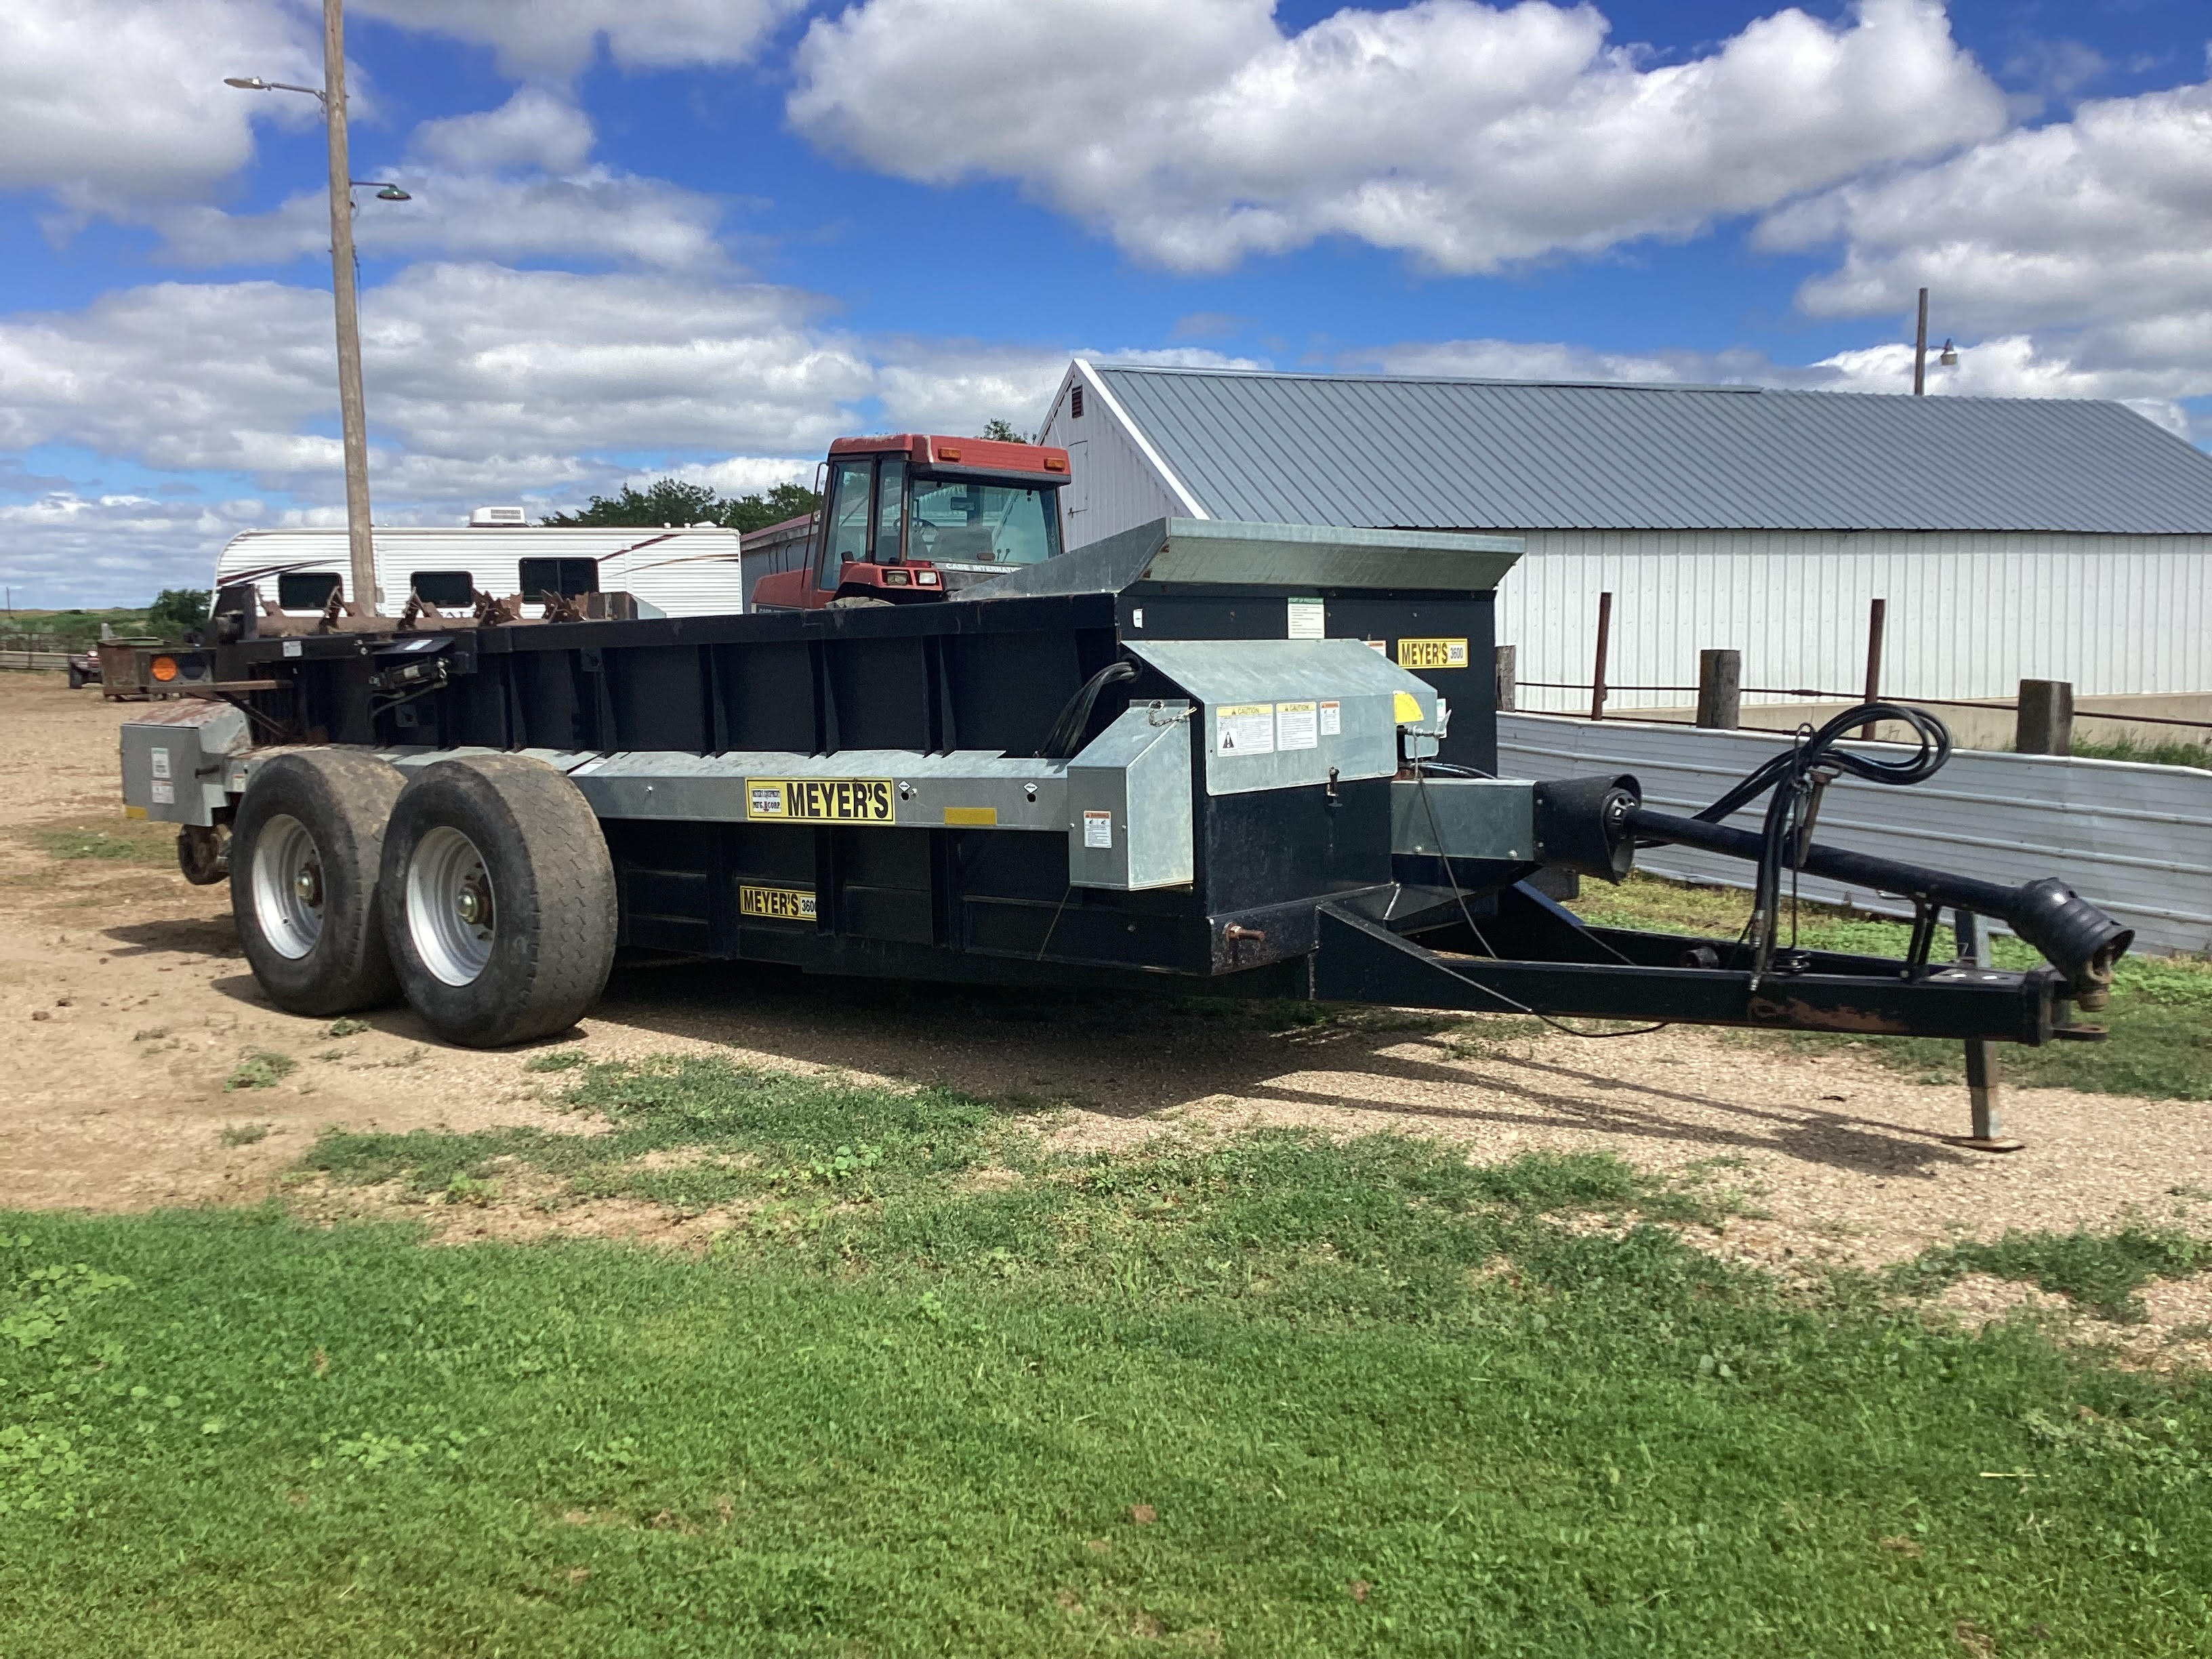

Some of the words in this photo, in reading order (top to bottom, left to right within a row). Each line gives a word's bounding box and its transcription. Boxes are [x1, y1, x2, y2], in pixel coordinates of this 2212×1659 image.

[945, 562, 970, 571] CASE
[1401, 642, 1448, 665] MEYER'S
[1450, 647, 1464, 659] 3600
[1237, 707, 1260, 716] CAUTION
[786, 782, 889, 819] MEYER'S
[743, 889, 800, 916] MEYER'S
[801, 899, 816, 913] 360
